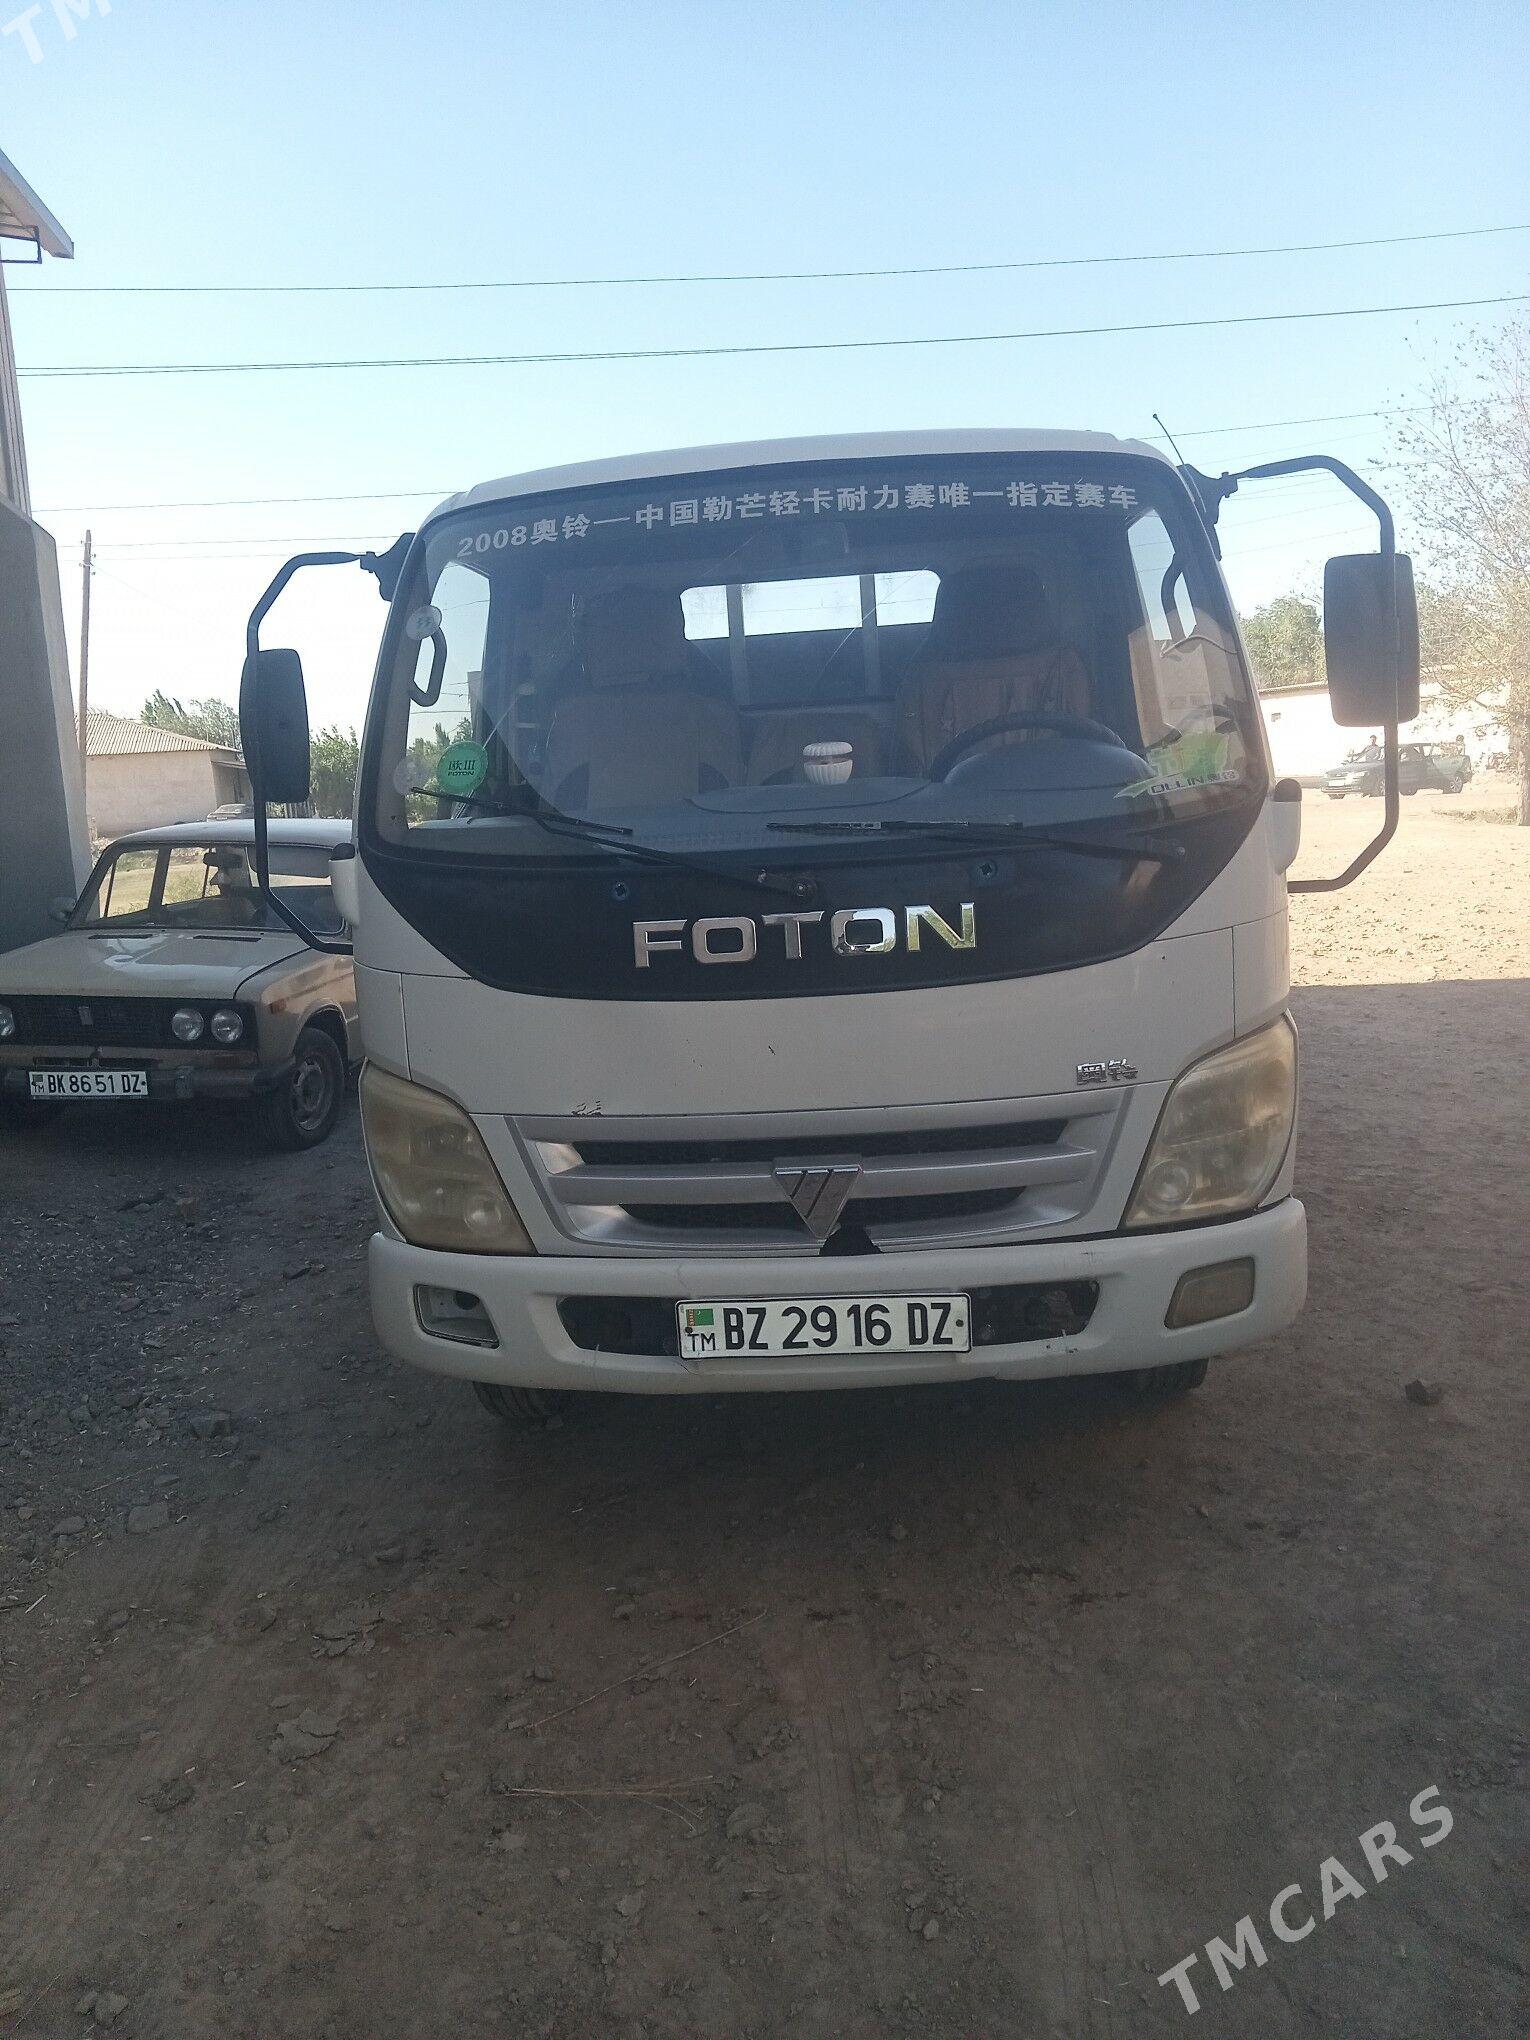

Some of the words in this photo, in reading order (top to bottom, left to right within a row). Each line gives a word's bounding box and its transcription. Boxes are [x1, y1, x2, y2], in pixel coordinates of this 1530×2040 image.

[632, 901, 977, 968] FOTON
[47, 1074, 66, 1094] BK
[121, 1074, 142, 1093] DZ
[686, 1332, 717, 1352] TM
[722, 1307, 769, 1350] BZ
[906, 1302, 954, 1346] DZ
